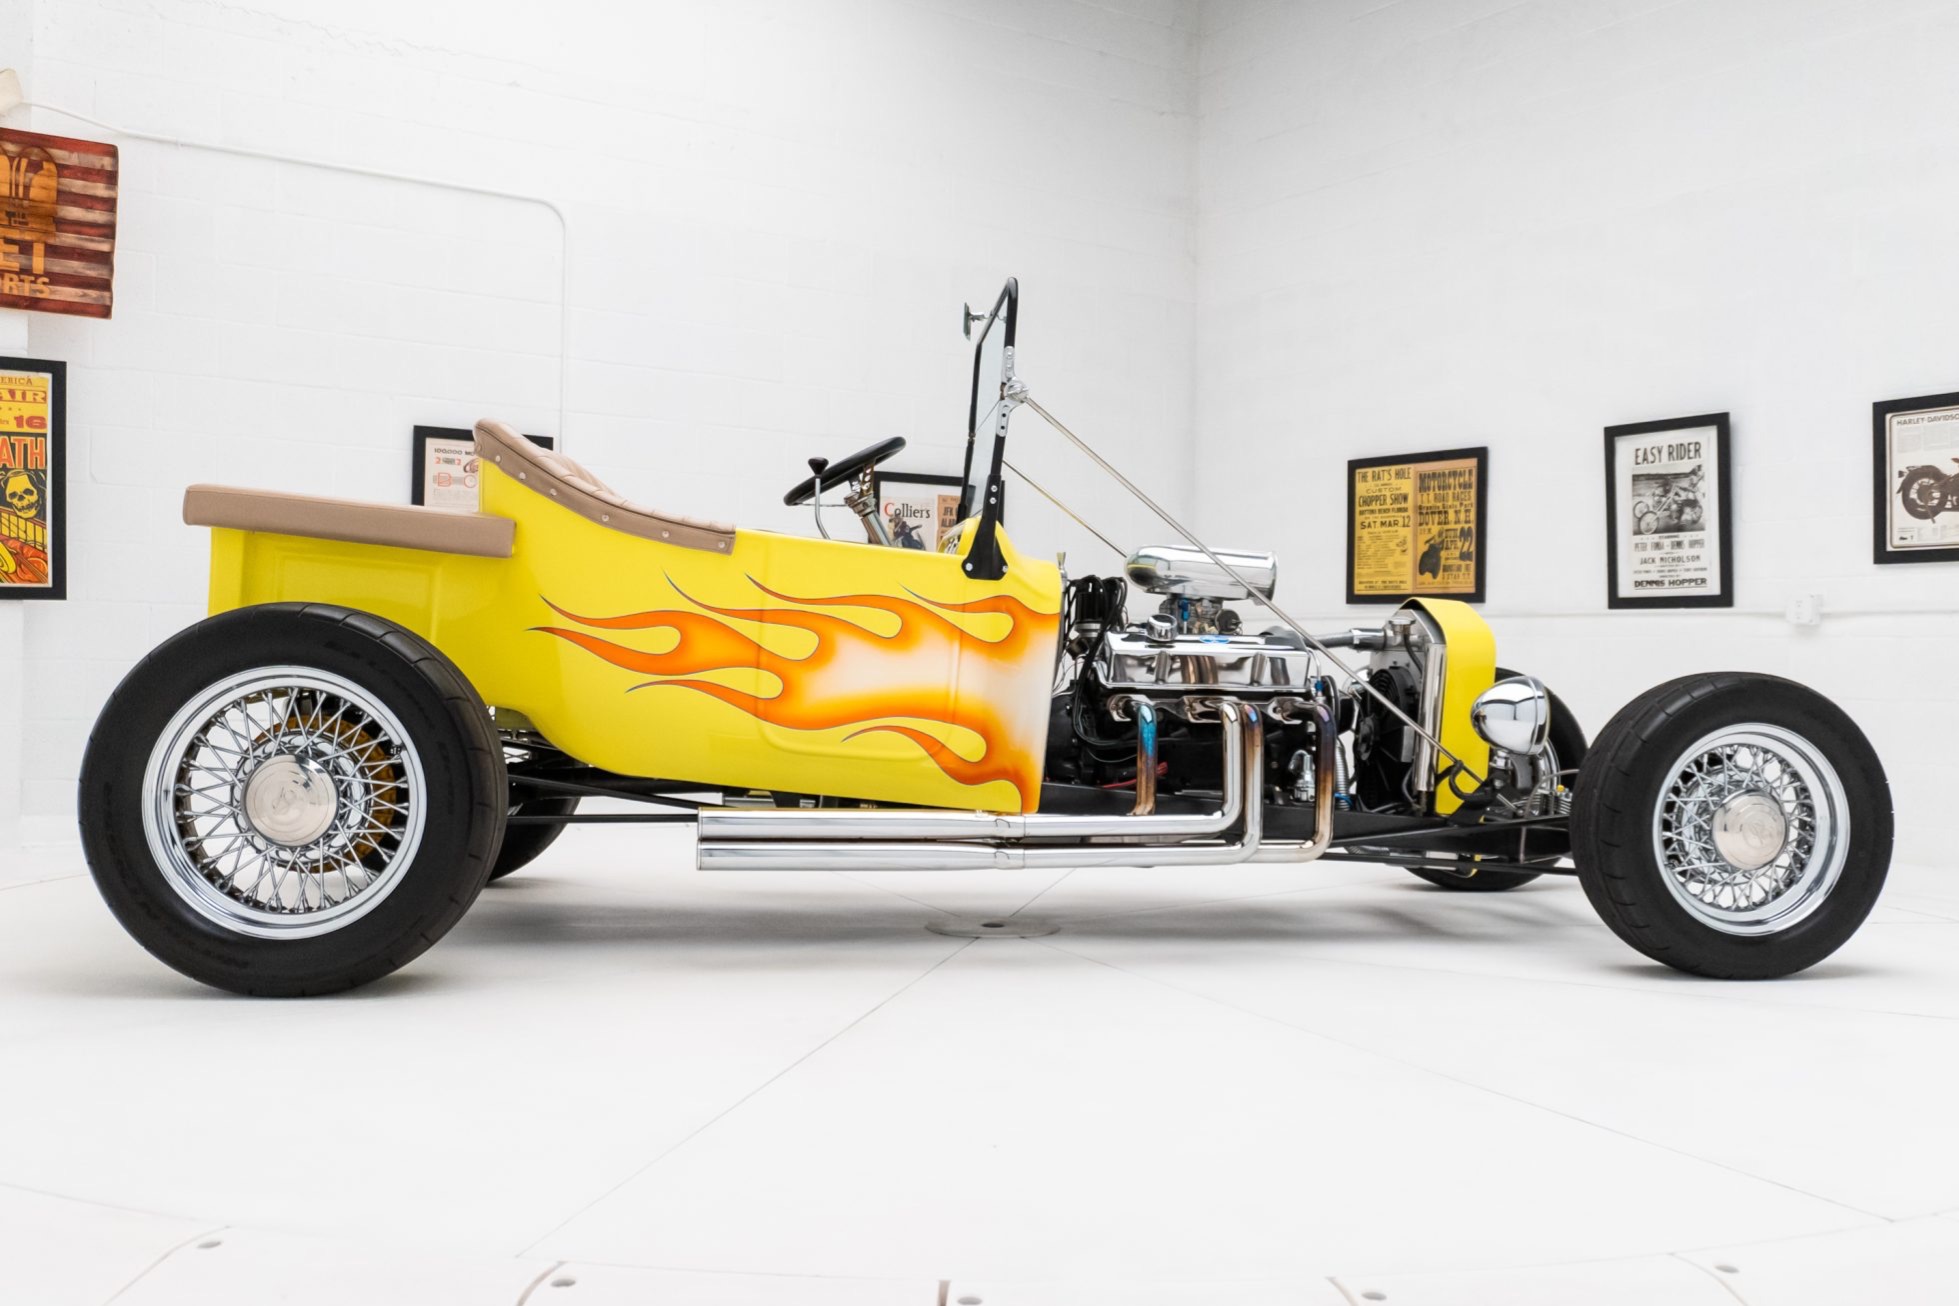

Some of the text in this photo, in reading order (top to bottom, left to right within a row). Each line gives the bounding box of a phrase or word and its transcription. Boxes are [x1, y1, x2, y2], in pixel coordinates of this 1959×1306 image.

[0, 273, 50, 298] RTS
[14, 415, 47, 429] 16
[0, 436, 46, 469] ATH
[1635, 441, 1702, 466] EASY RIDER
[1357, 466, 1412, 484] THE RAT'S HOLE
[1419, 469, 1473, 493] MOTORCYCLE
[1366, 486, 1402, 494] CUSTOM
[1452, 490, 1471, 502] RACES
[1358, 492, 1409, 508] CHOPPER SHOW
[1402, 515, 1411, 528] 12
[1459, 526, 1474, 562] 22
[1640, 554, 1701, 565] JACK NICHOLSON
[1634, 578, 1707, 588] DENNIS HOPPER
